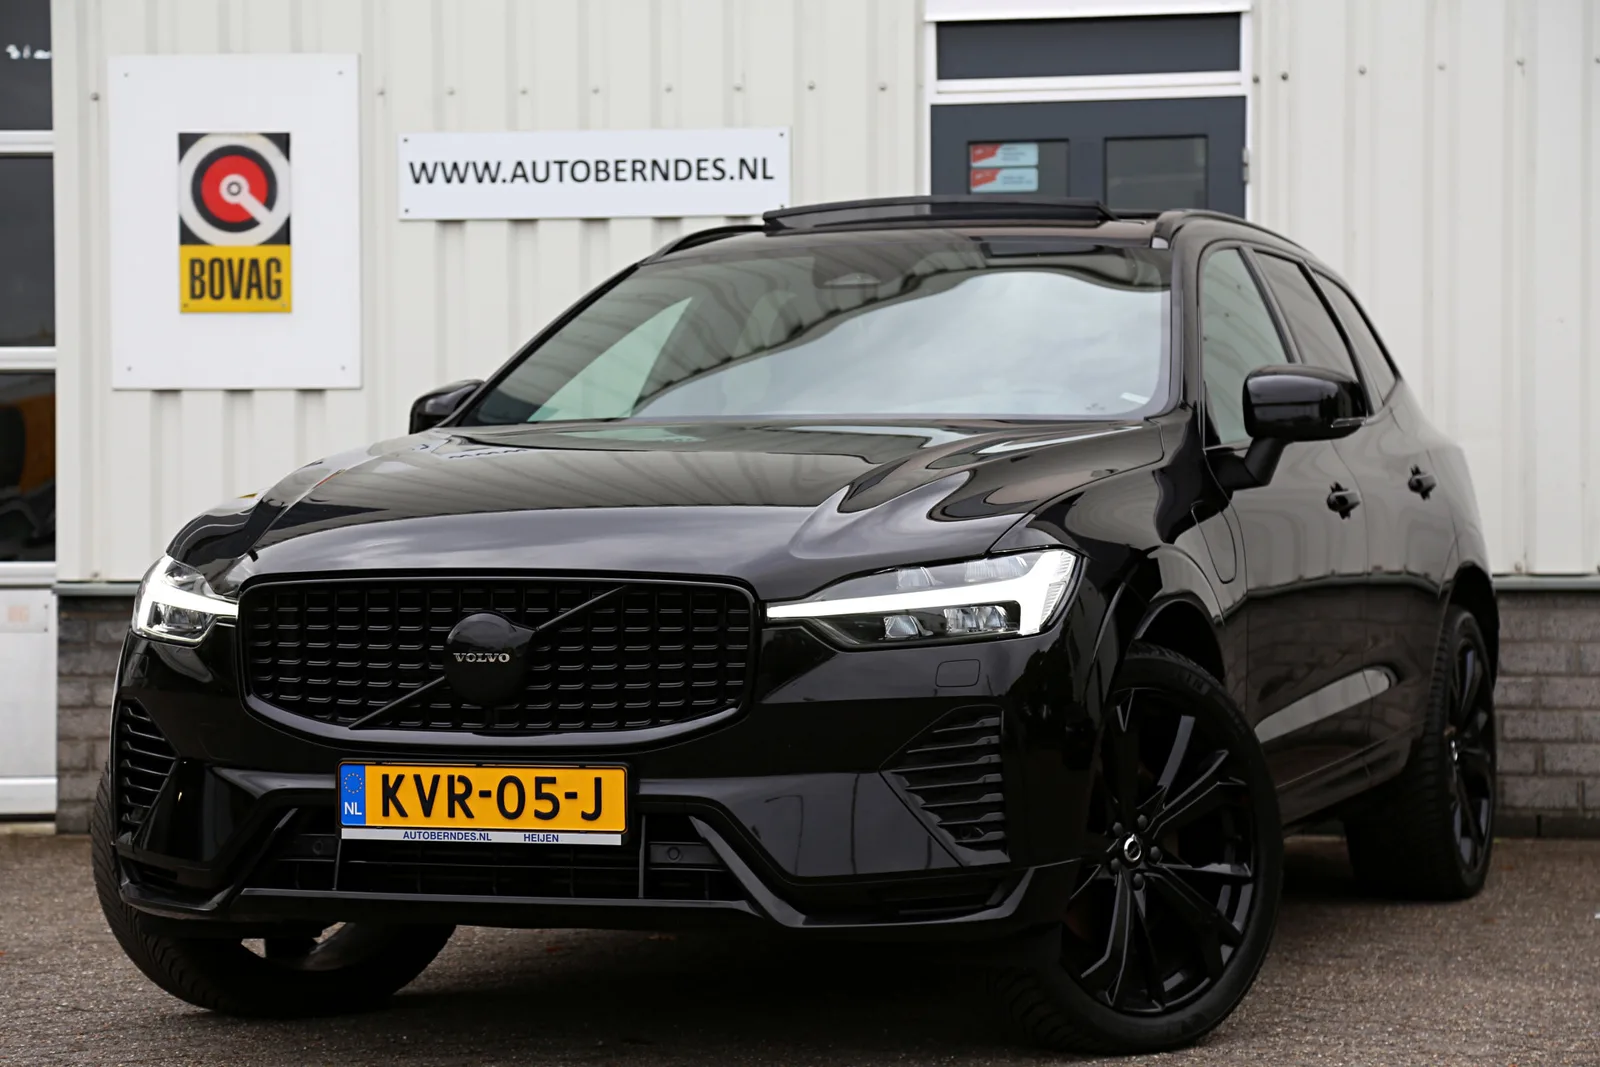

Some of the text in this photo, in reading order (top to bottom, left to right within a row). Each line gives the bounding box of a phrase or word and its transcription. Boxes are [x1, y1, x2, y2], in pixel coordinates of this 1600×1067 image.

[409, 157, 775, 184] WWW.AUTOBERNDES.NL
[189, 258, 282, 301] BOVAG
[453, 652, 510, 663] VOLVO
[381, 773, 602, 821] KVR-05-J
[344, 802, 362, 816] NL
[403, 831, 559, 843] AUTOBERNDES.NL HEIJEN
